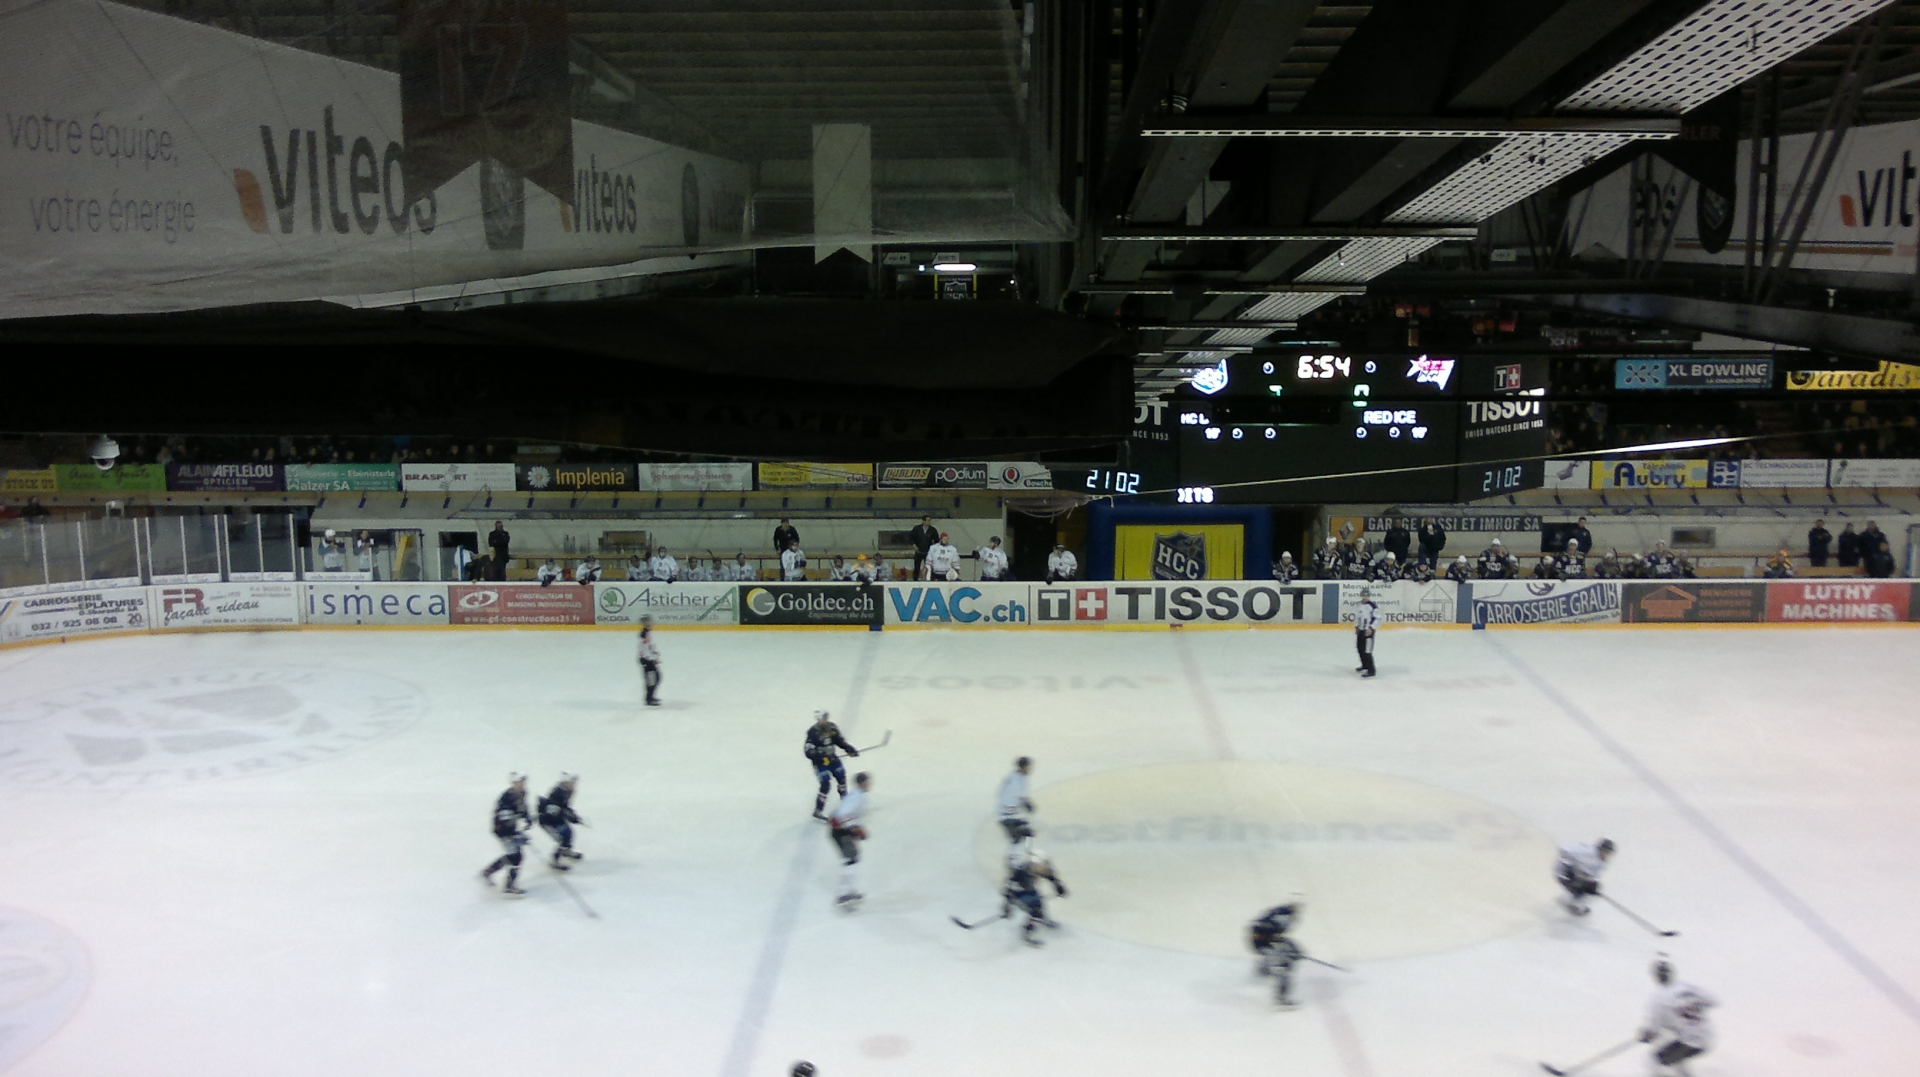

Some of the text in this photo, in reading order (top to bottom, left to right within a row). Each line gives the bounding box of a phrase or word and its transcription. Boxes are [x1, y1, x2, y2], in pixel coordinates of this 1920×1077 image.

[7, 111, 83, 153] votre
[30, 188, 195, 244] votre énergie
[1297, 355, 1351, 379] 6:54
[1668, 363, 1767, 376] XL BOWLING
[333, 480, 350, 490] SA
[556, 468, 625, 489] Implenia
[1614, 462, 1686, 488] Aubry
[1368, 517, 1417, 530] GARGE
[1462, 517, 1476, 530] ET
[1524, 517, 1540, 530] SA
[1157, 542, 1200, 580] HCC
[23, 593, 103, 608] CARROSSERIE
[309, 586, 446, 616] ismeca
[628, 588, 709, 607] Asticher
[777, 592, 874, 611] Goldec.ch
[1476, 596, 1568, 624] CARROSSERIE
[1569, 582, 1618, 615] GRAUB
[1804, 584, 1876, 600] LUTHY
[217, 599, 260, 613] rideau
[888, 587, 1025, 623] VAC.ch
[1115, 586, 1317, 621] TISSOT
[1782, 603, 1895, 619] MACHINES
[1046, 815, 1454, 844] ostFinance
